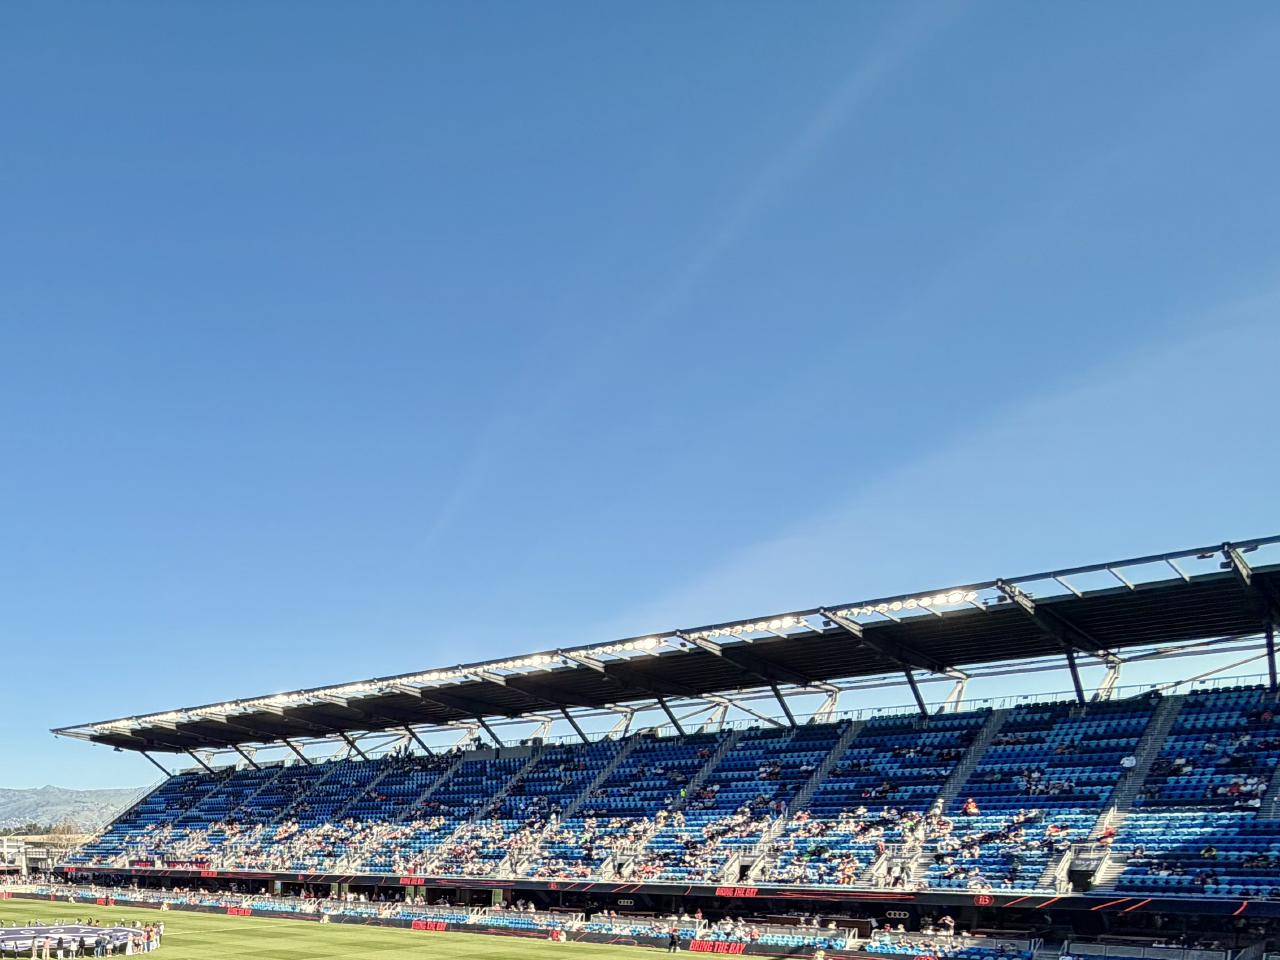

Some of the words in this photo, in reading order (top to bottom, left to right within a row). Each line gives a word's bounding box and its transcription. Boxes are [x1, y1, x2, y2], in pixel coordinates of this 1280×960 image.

[689, 940, 713, 952] BRING
[714, 941, 729, 953] THE
[728, 943, 746, 954] BAY
